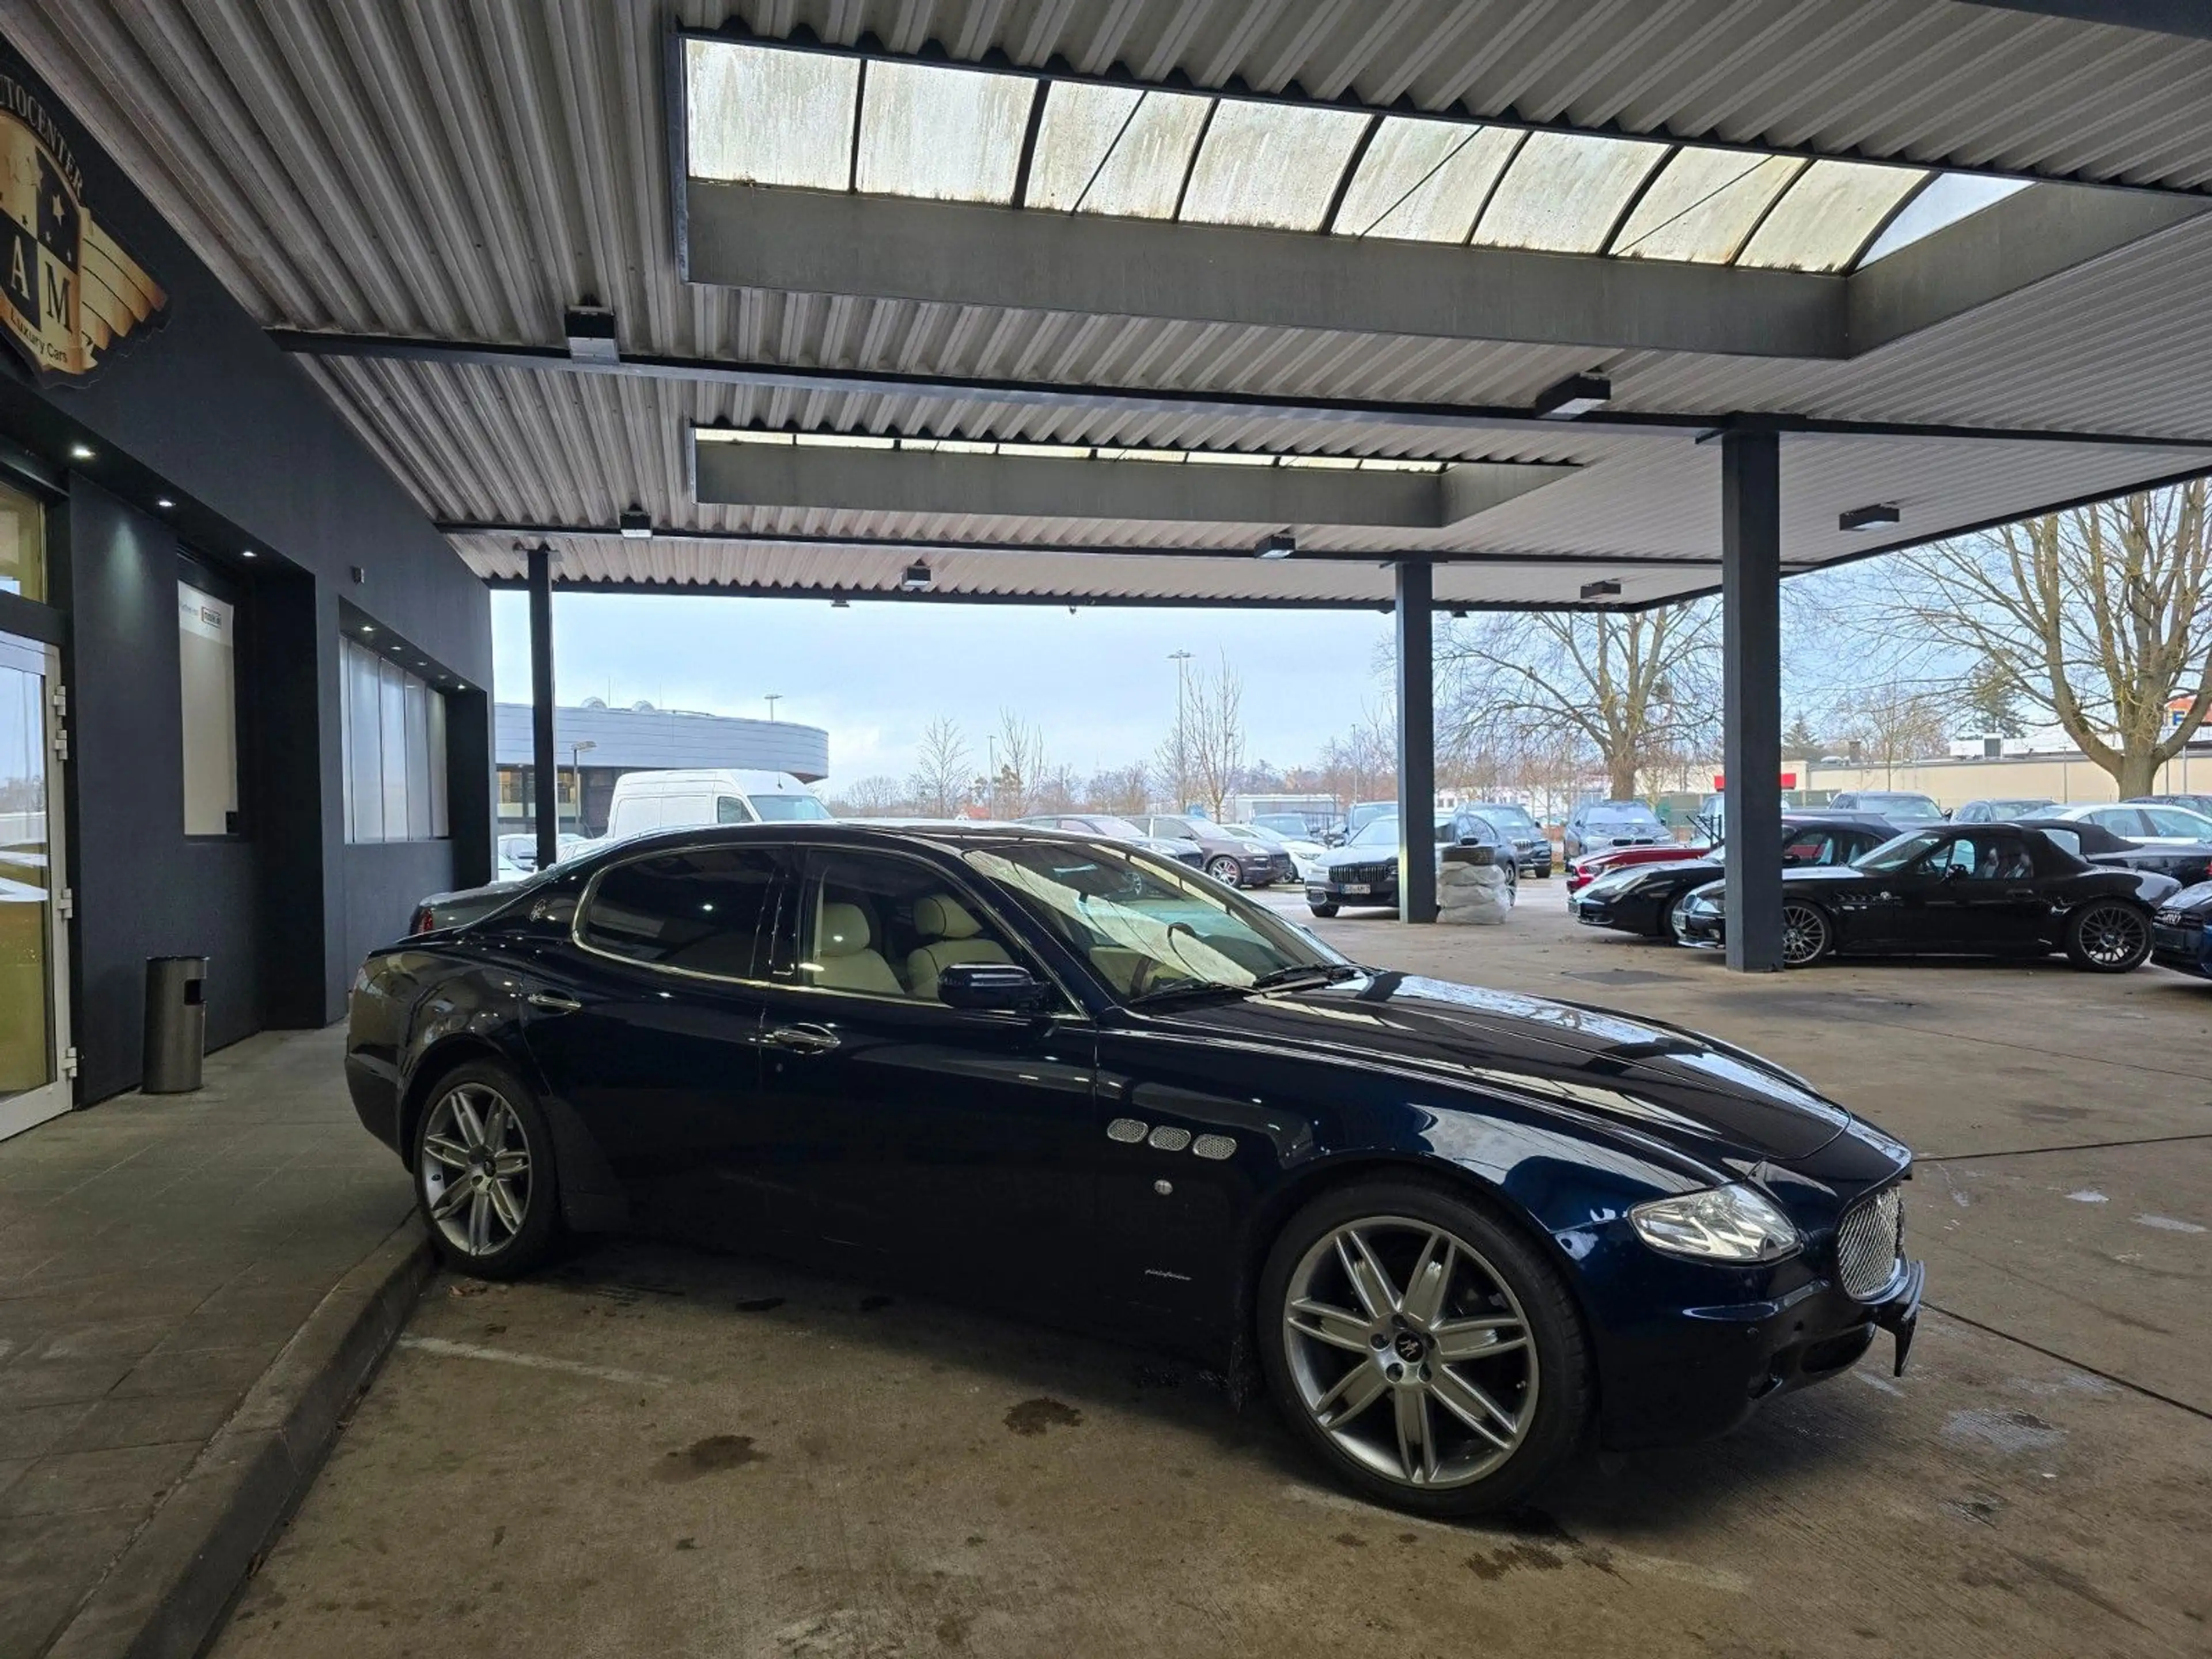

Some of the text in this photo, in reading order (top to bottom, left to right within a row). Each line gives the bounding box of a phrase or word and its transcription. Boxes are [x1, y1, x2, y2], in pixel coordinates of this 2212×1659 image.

[0, 75, 83, 200] TOCENTER
[10, 307, 68, 363] Luxury Cars
